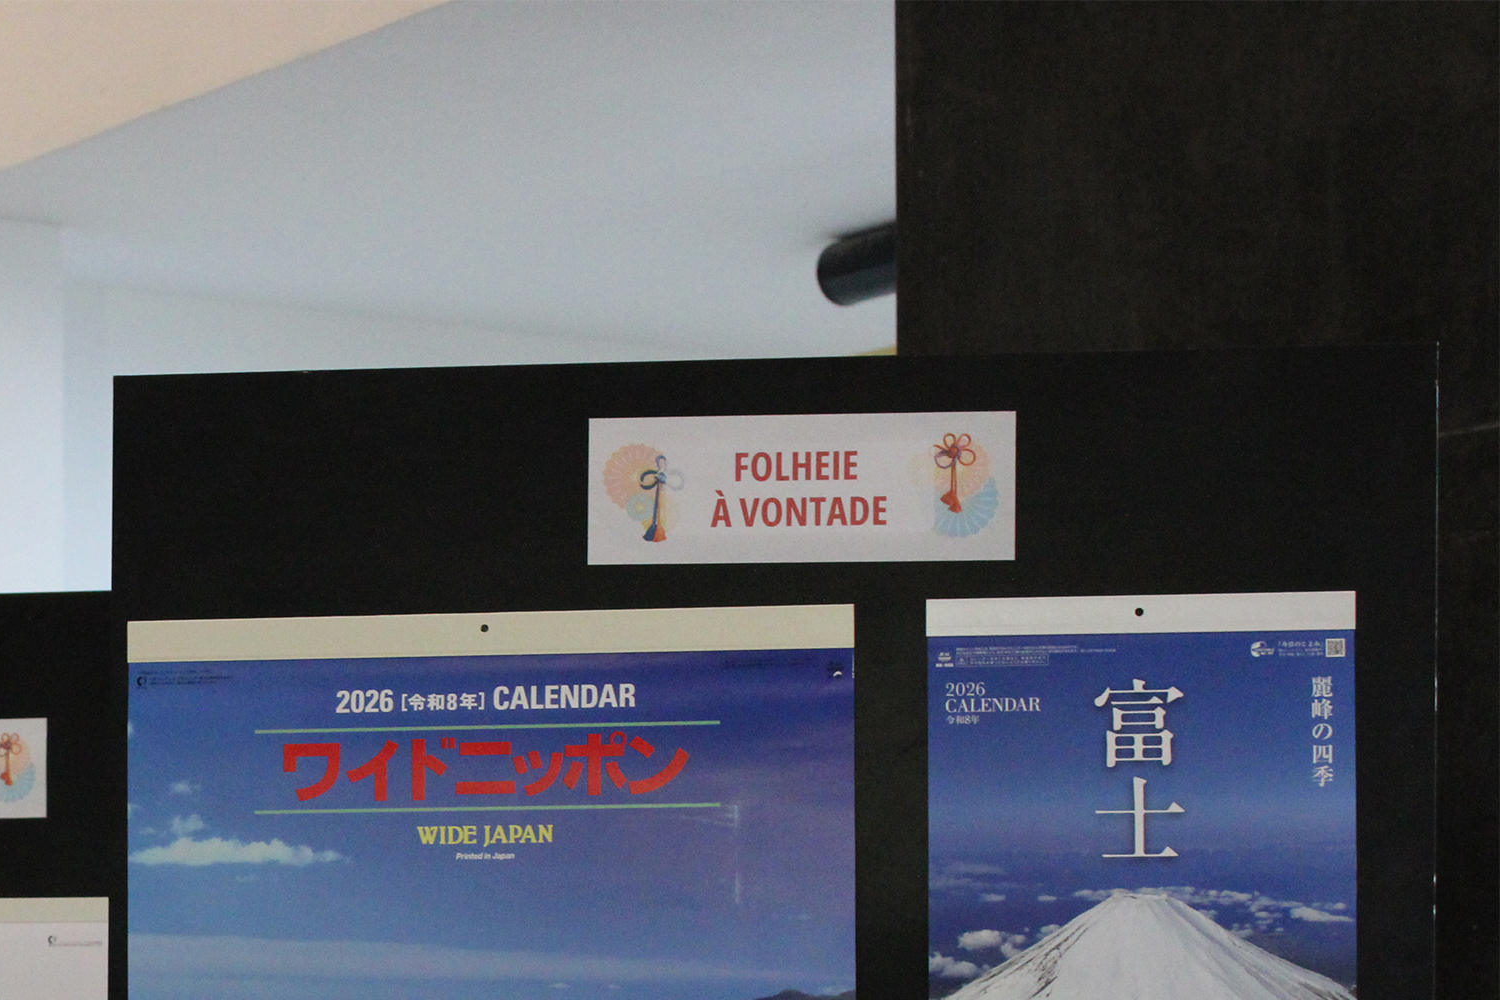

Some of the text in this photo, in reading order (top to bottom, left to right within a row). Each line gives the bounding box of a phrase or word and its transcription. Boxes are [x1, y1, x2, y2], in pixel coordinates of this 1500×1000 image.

[734, 450, 858, 482] FOLHEIE
[710, 490, 887, 528] À VONTADE
[336, 690, 394, 714] 2026
[493, 683, 636, 711] CALENDAR
[945, 682, 986, 697] 2026
[945, 697, 1041, 713] CALENDAR
[1310, 676, 1334, 788] 麗峰の四季
[283, 732, 689, 802] ワイドニッポン
[1094, 678, 1185, 859] 富士
[417, 824, 554, 847] WIDE JAPAN
[455, 852, 483, 860] Printed
[492, 852, 515, 861] Japan
